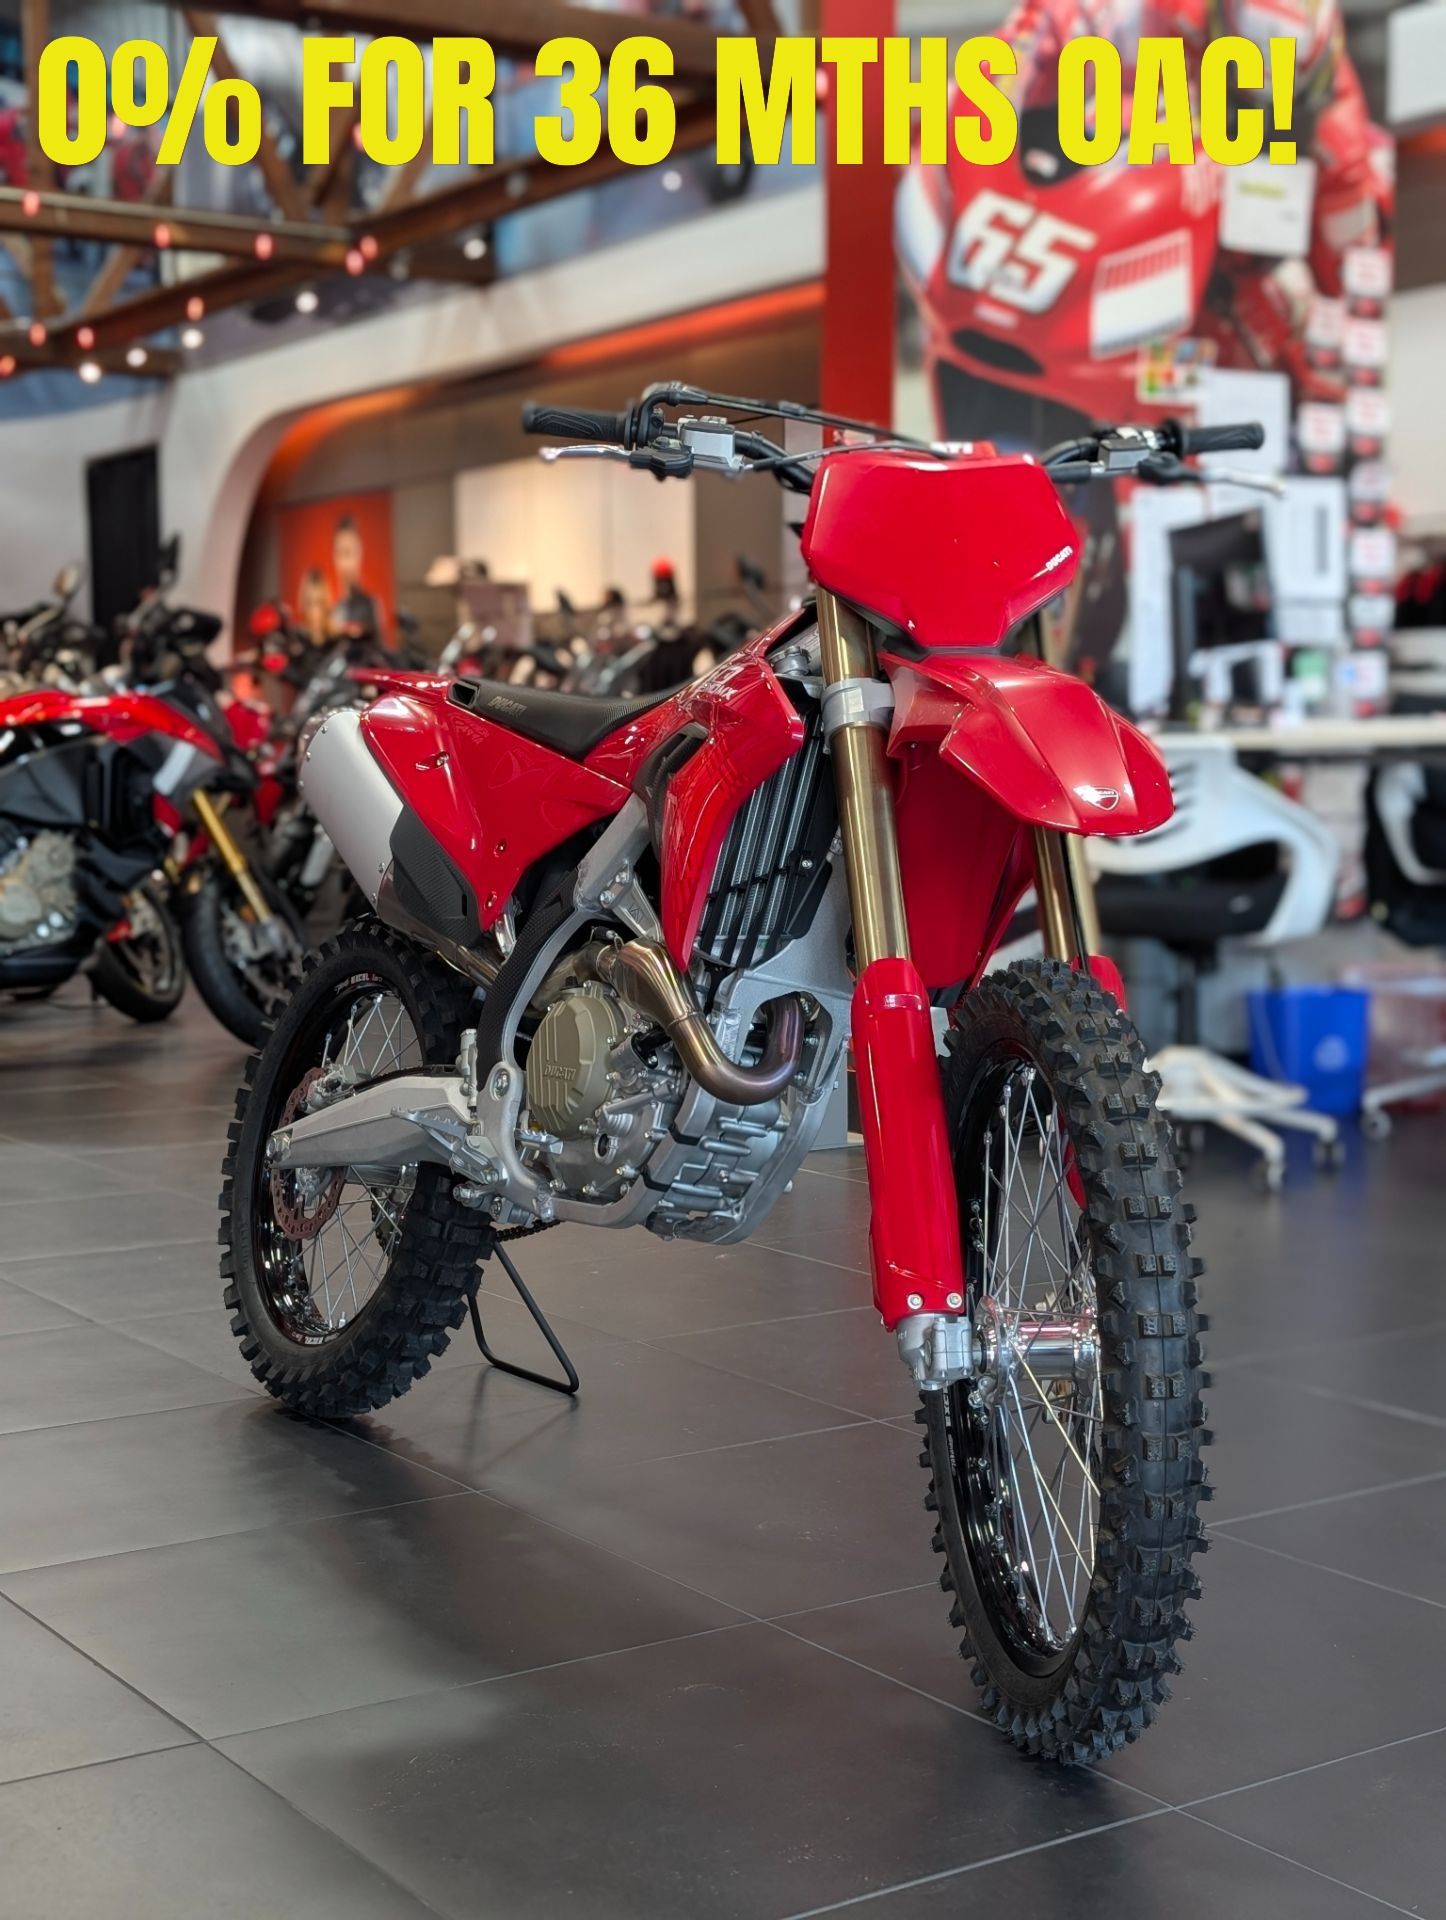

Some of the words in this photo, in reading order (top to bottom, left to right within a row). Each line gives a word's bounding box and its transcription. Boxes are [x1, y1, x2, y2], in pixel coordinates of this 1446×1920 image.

[947, 188, 1097, 316] 65
[1045, 545, 1073, 571] DUCATI
[487, 695, 528, 717] DUCATI
[544, 1064, 577, 1081] DUCATI
